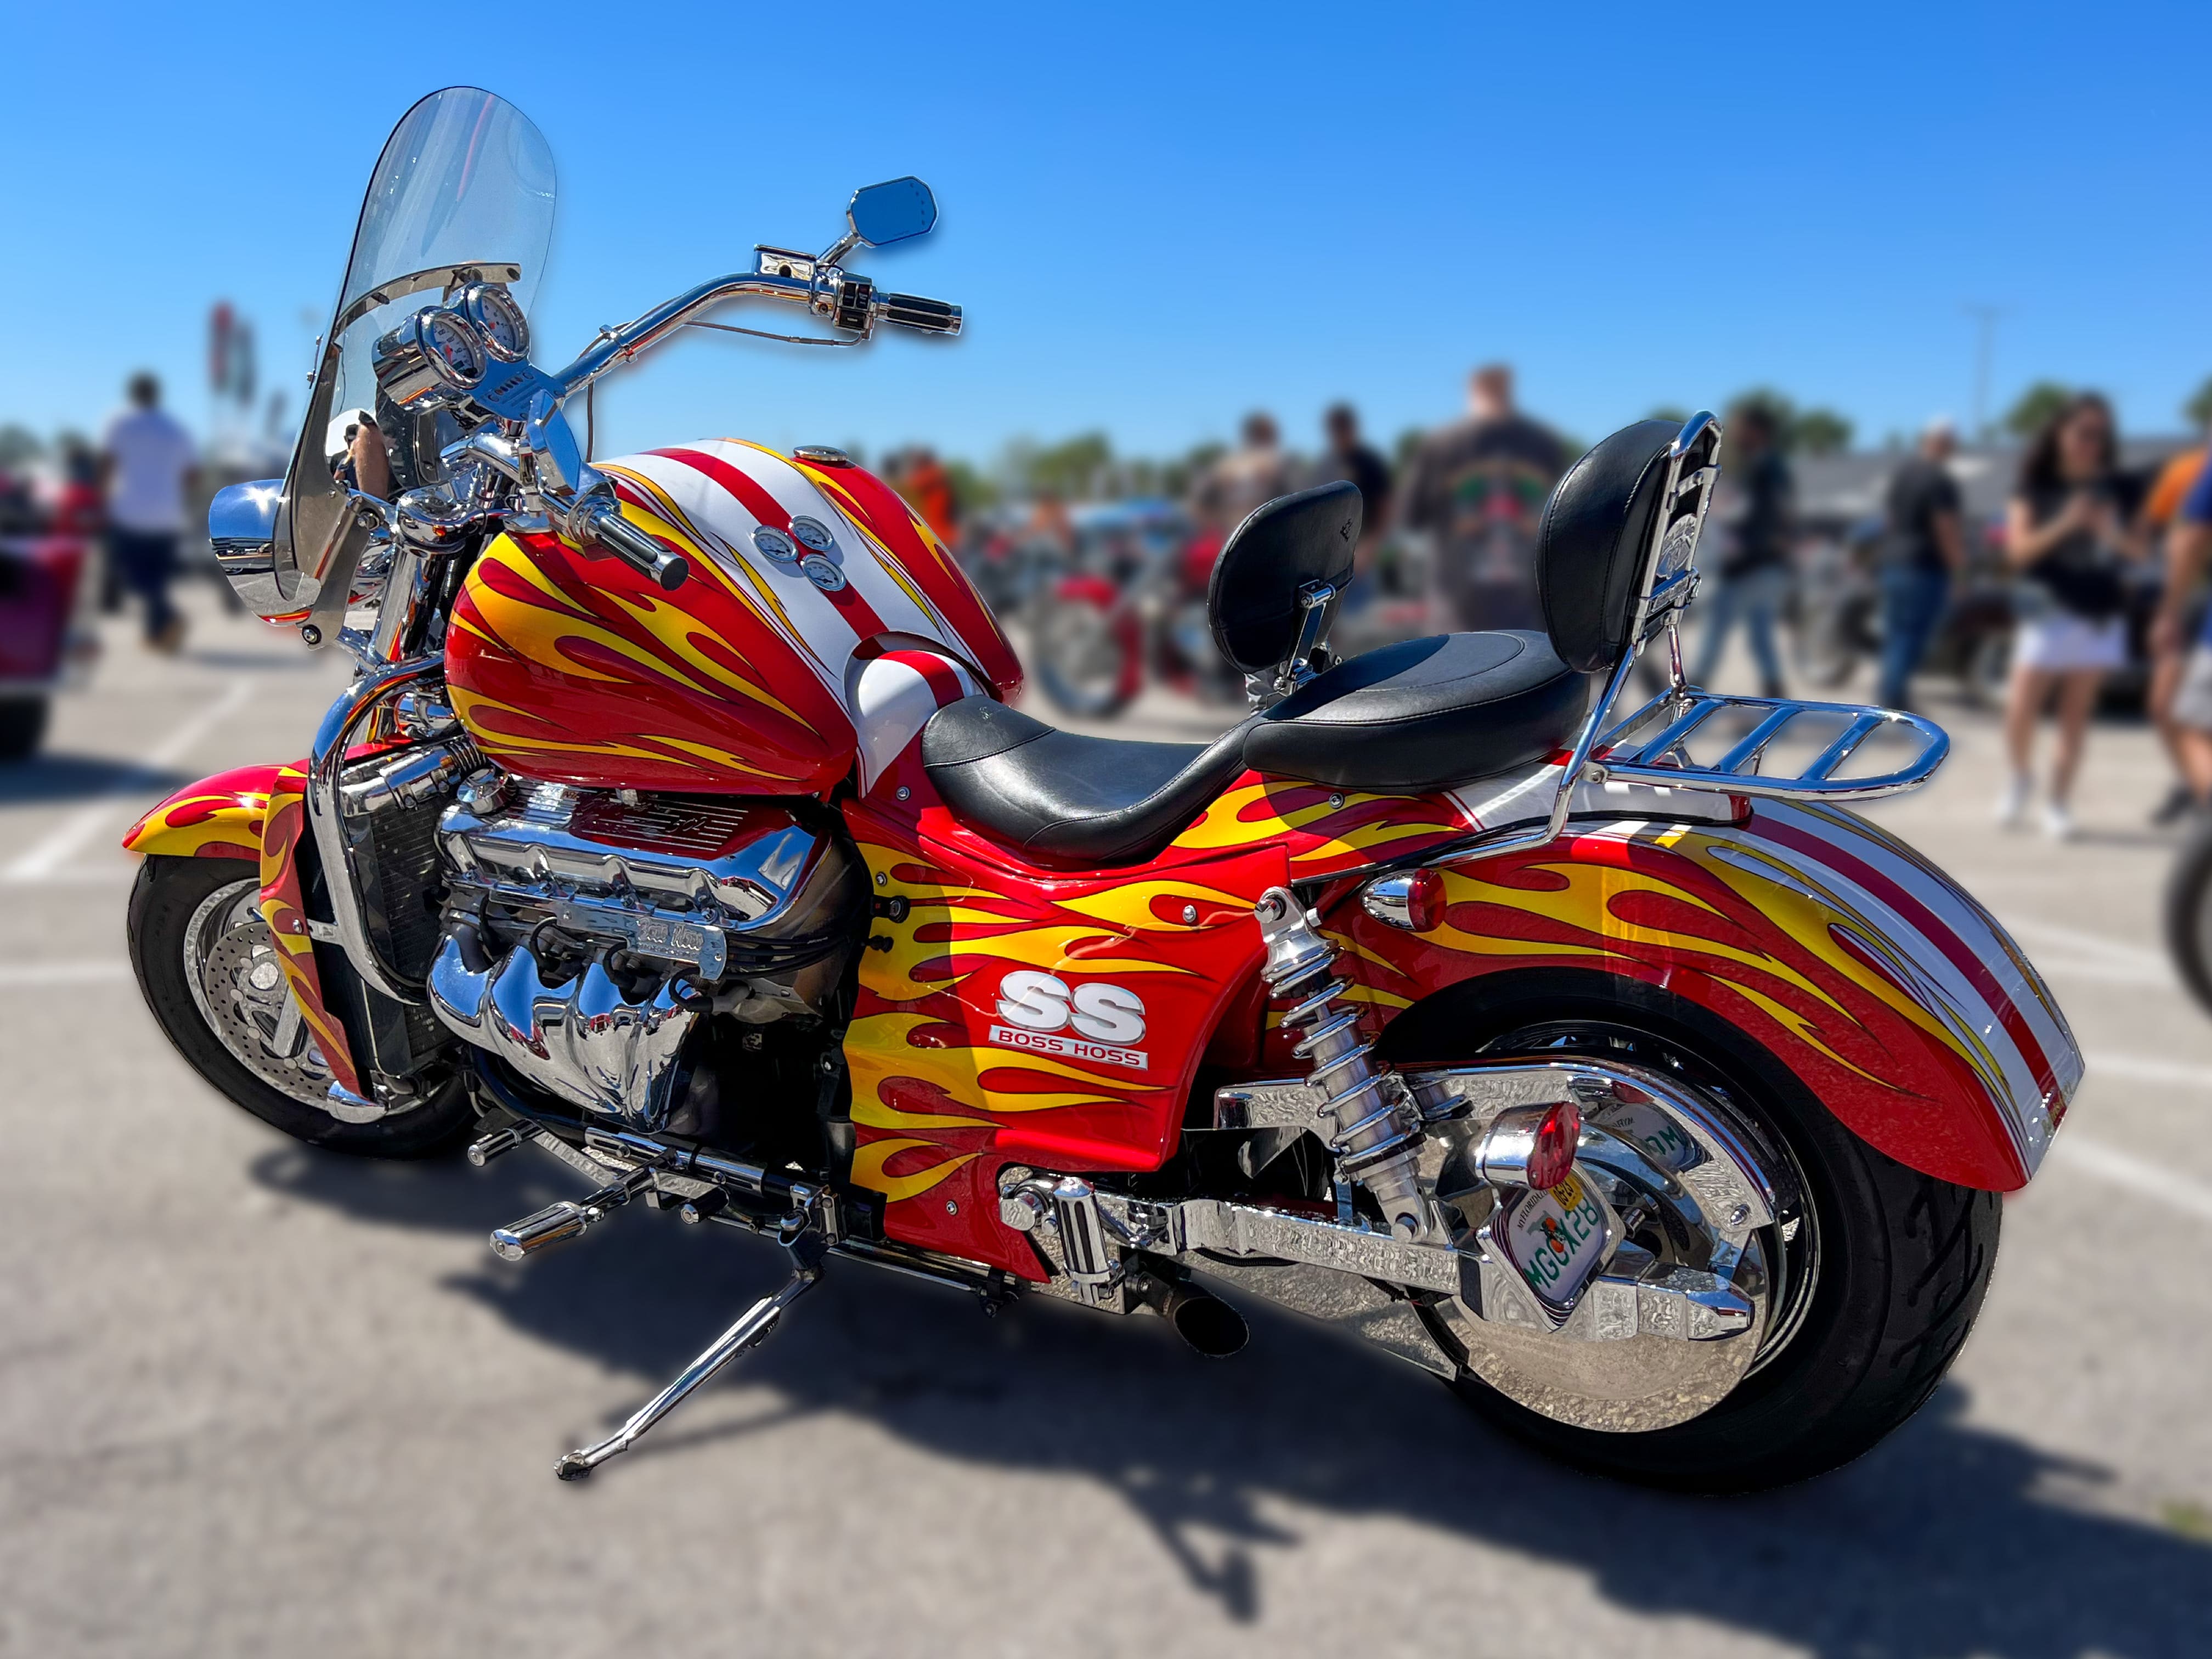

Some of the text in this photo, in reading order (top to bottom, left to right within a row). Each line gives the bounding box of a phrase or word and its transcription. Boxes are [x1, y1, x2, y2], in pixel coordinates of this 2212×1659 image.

[995, 970, 1146, 1046] SS
[998, 1030, 1139, 1065] BOSS HOSS
